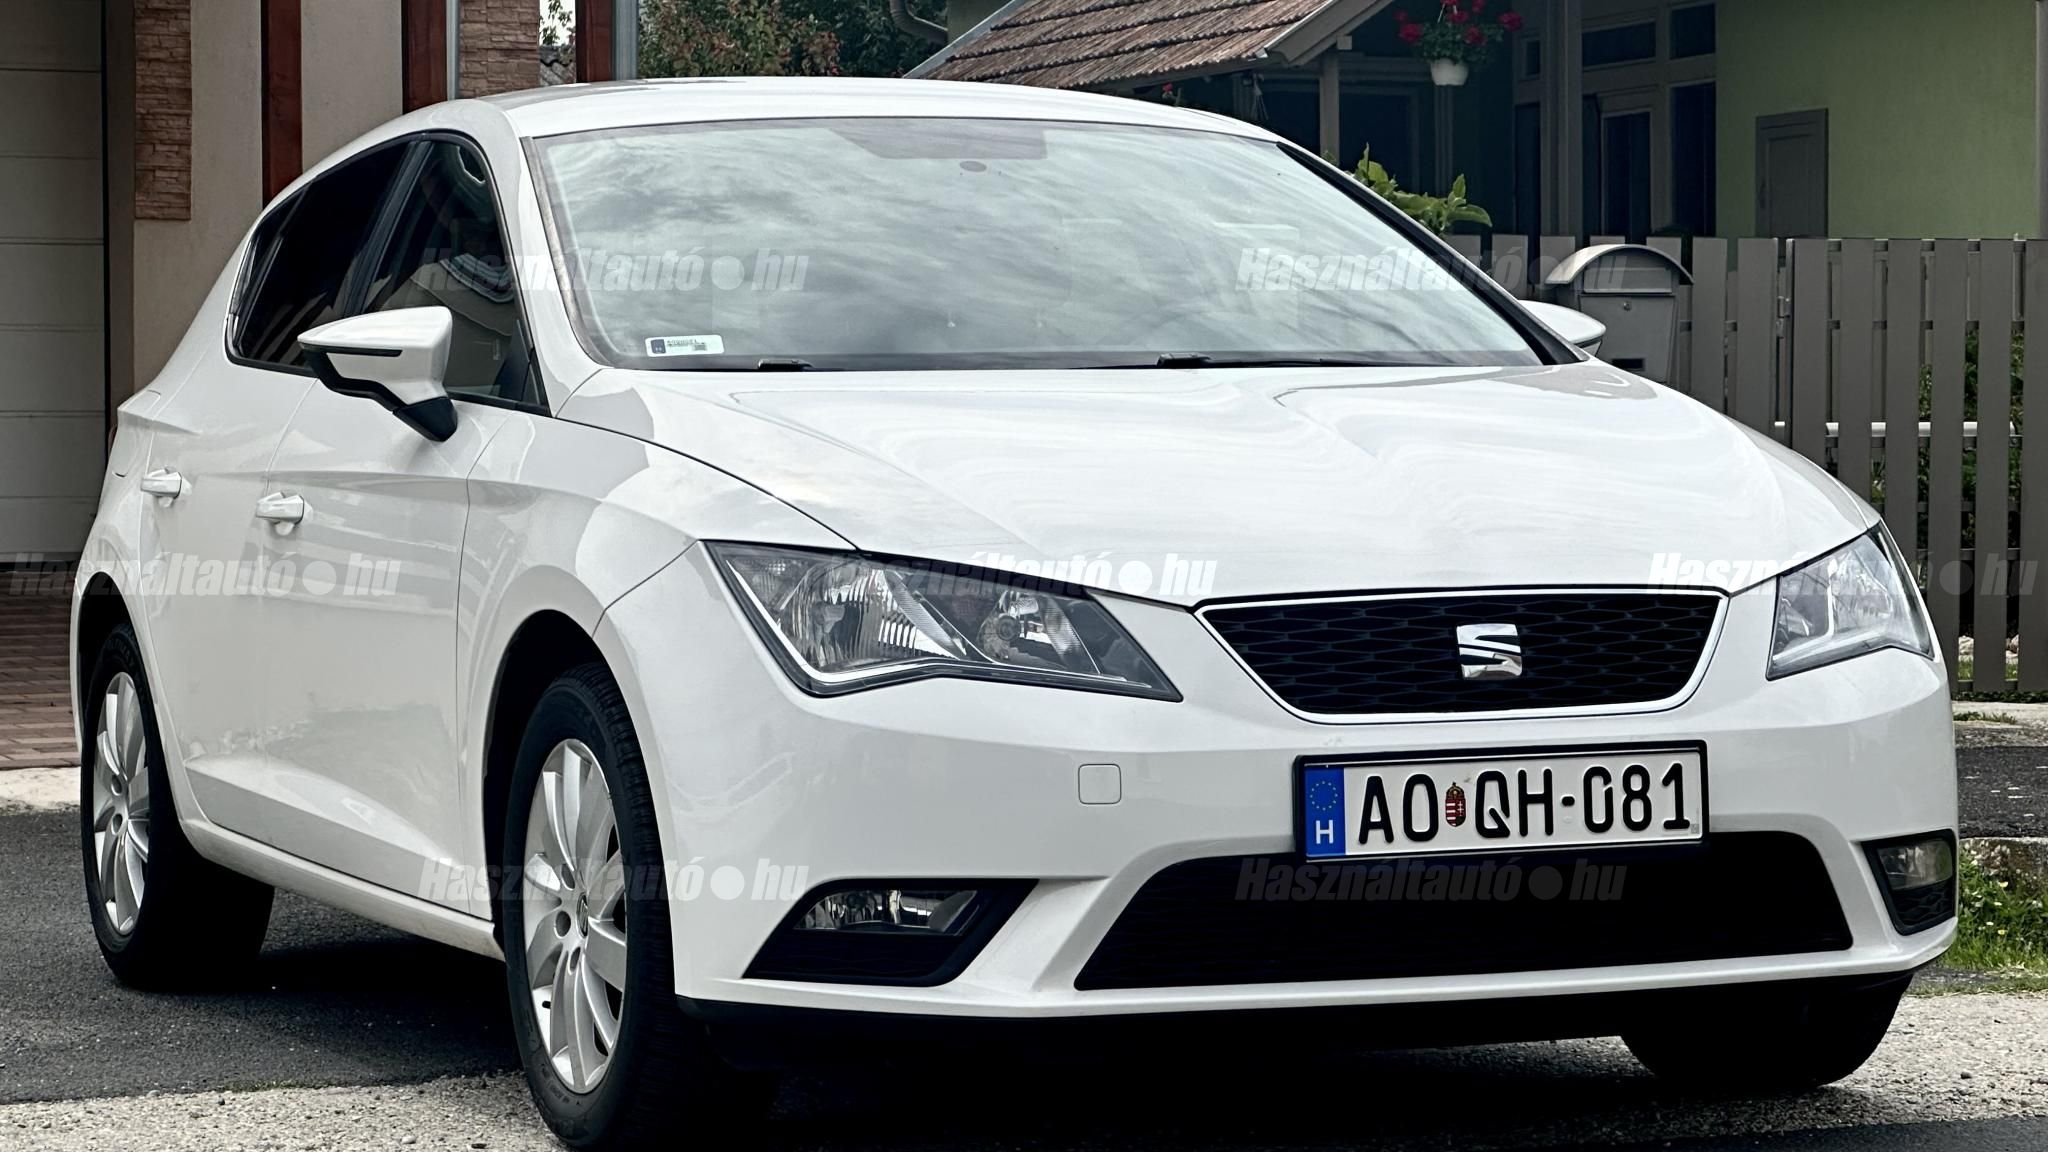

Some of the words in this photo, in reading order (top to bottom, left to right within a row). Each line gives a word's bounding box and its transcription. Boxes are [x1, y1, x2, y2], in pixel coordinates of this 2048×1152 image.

[1358, 773, 1439, 844] AO
[1475, 762, 1692, 838] QH-081
[1315, 819, 1334, 845] H
